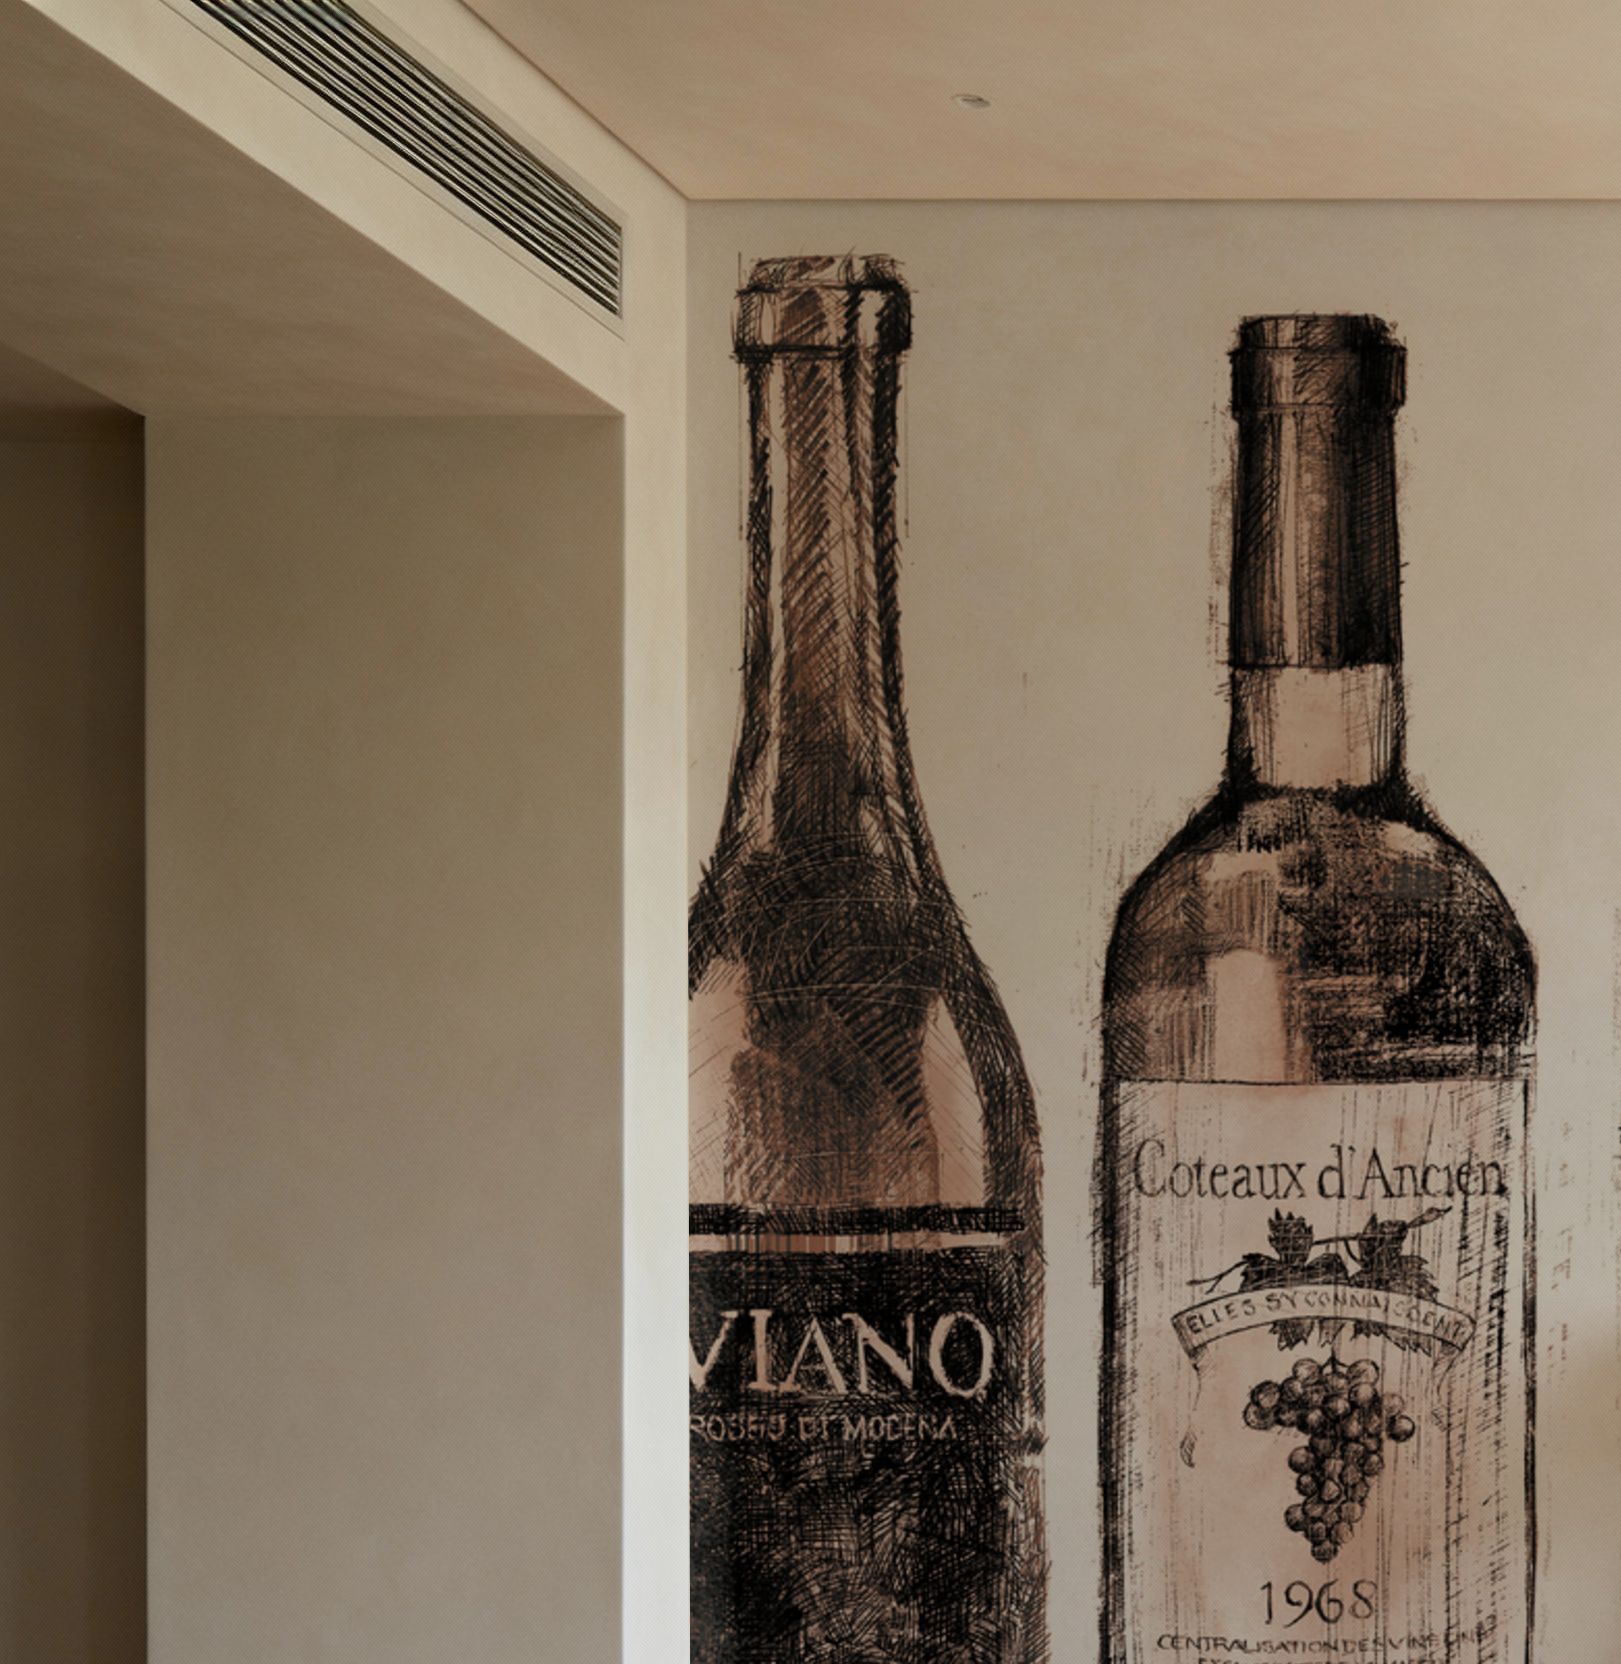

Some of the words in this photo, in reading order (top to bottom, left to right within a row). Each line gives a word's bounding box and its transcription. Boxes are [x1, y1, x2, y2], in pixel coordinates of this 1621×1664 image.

[1133, 1138, 1307, 1200] Coteaux
[689, 1308, 994, 1399] VIANO
[1260, 1578, 1380, 1629] 1968
